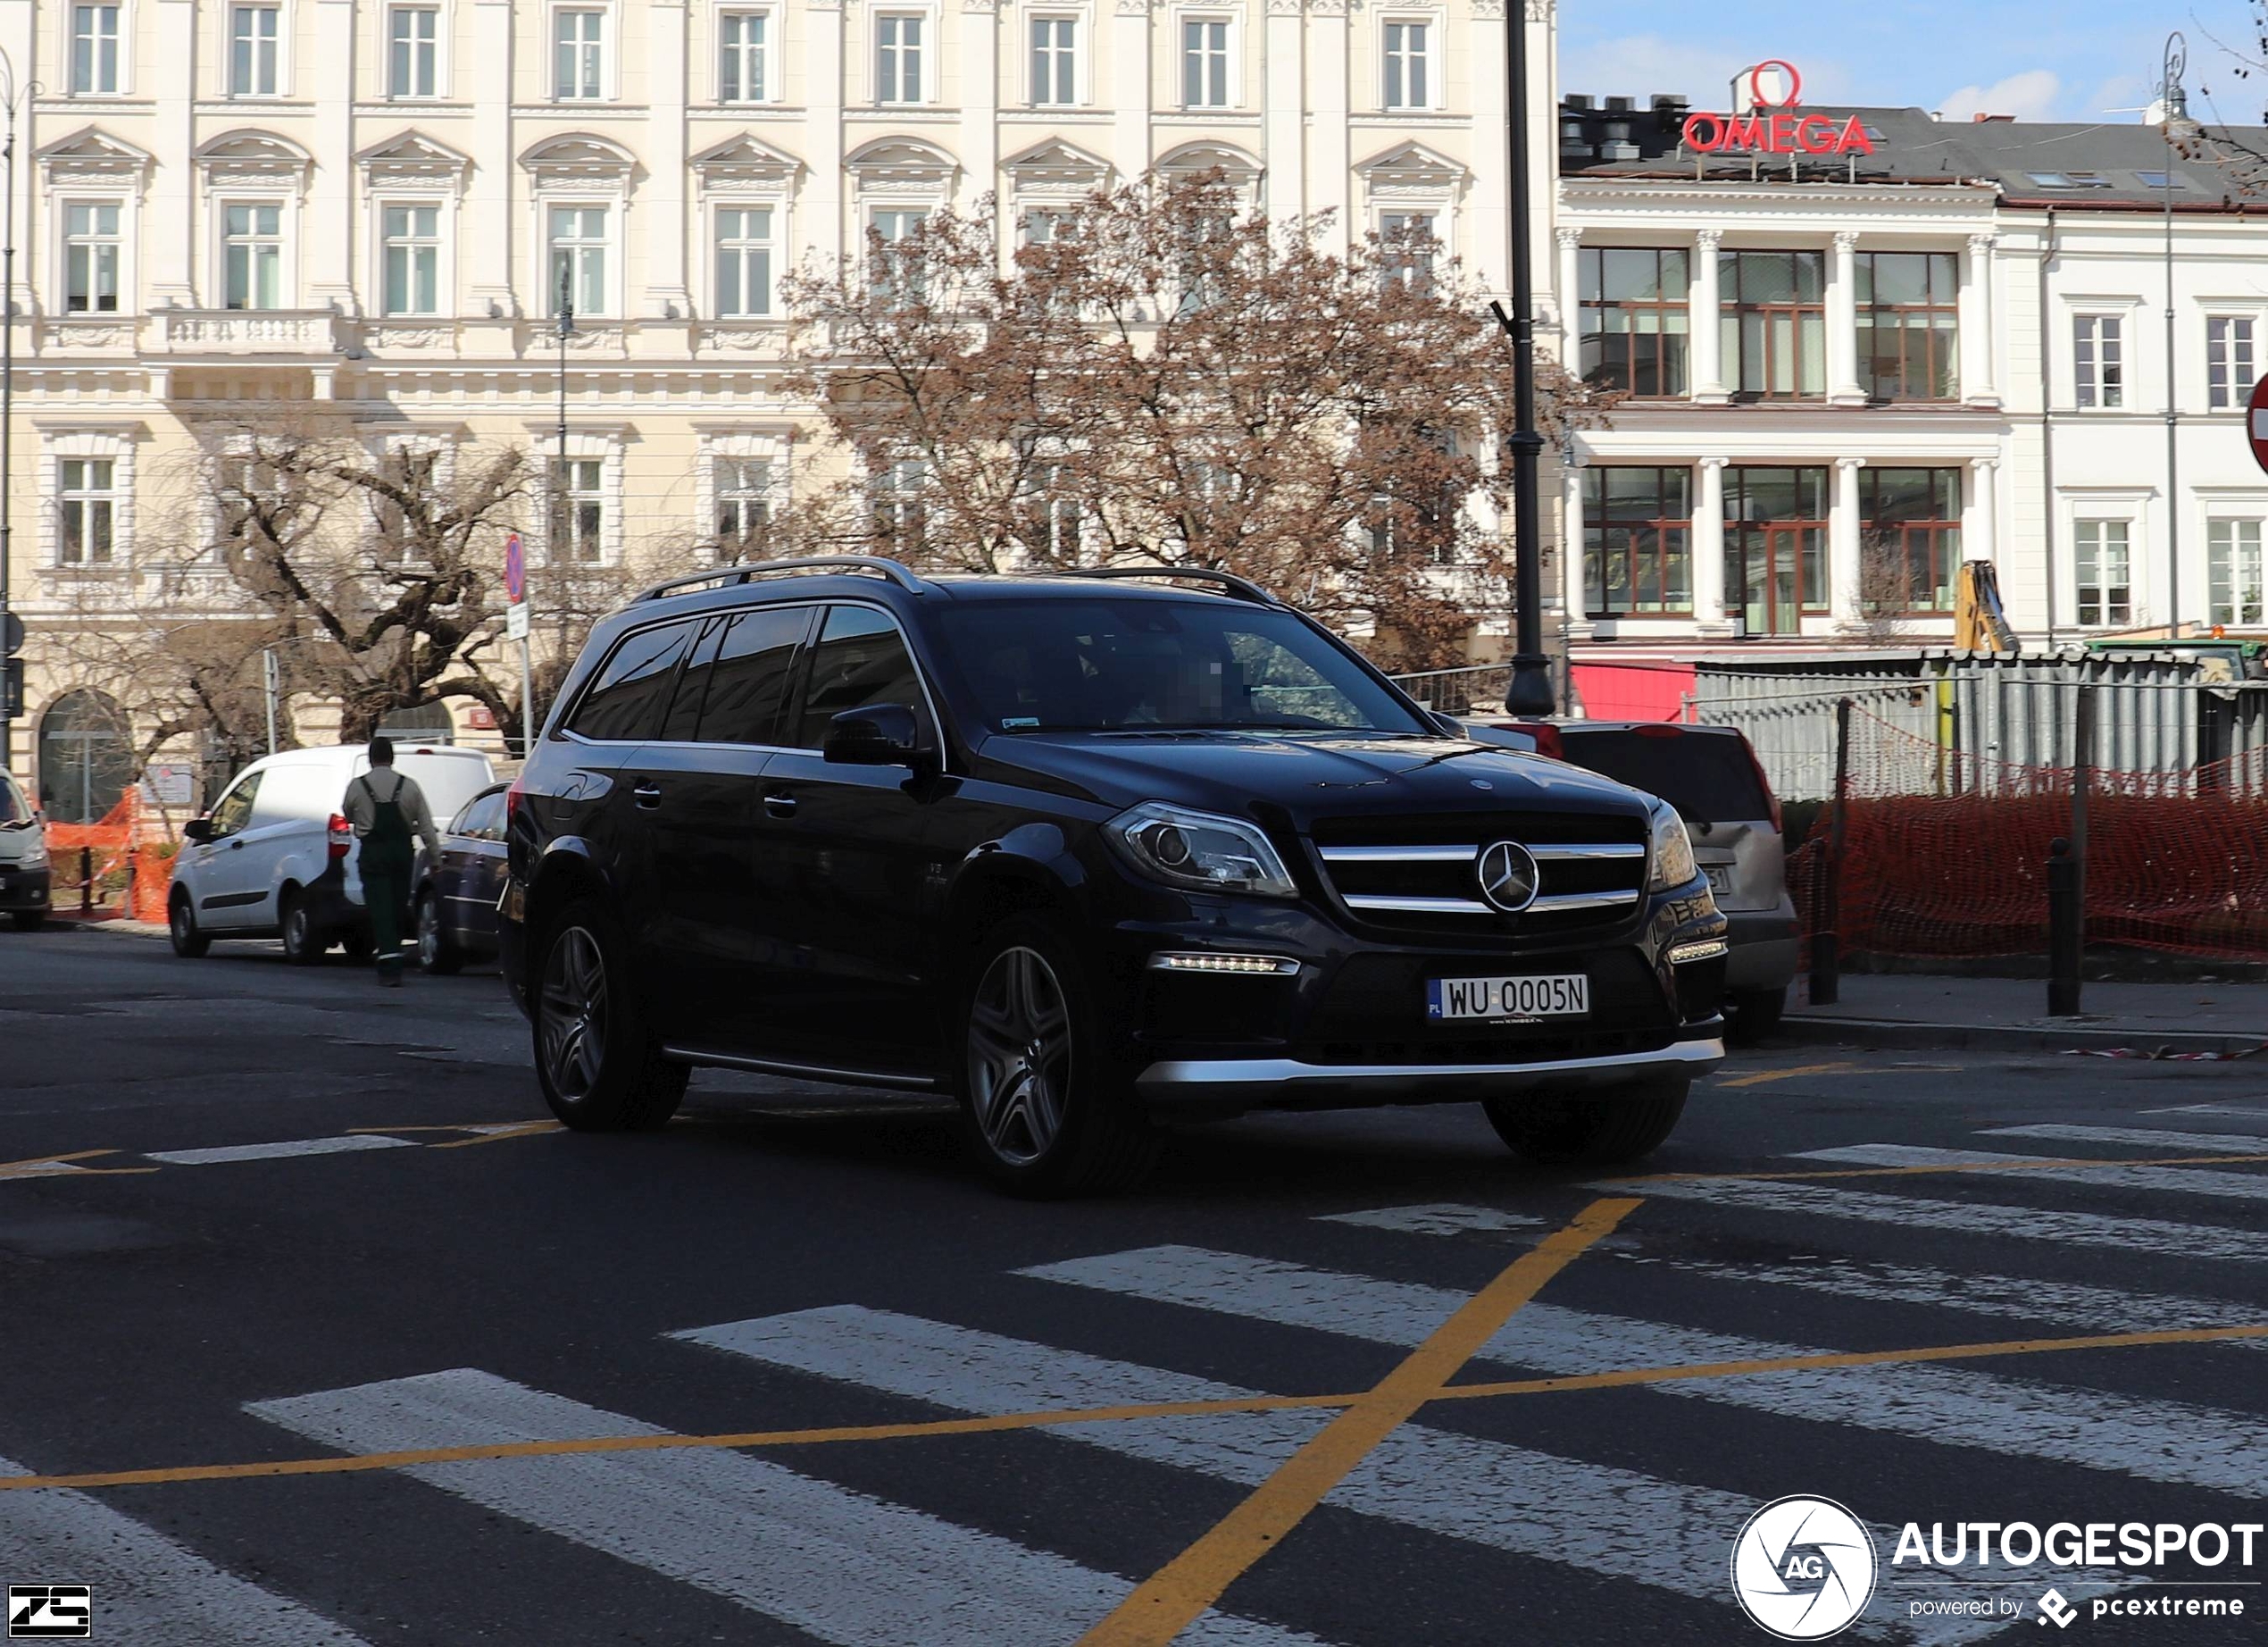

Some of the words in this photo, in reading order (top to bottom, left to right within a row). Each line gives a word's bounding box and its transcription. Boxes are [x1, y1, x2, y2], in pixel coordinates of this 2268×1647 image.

[1682, 113, 1874, 155] OMEGA
[1429, 1004, 1441, 1014] PL
[1448, 981, 1488, 1016] WU
[1501, 978, 1584, 1013] 0005N
